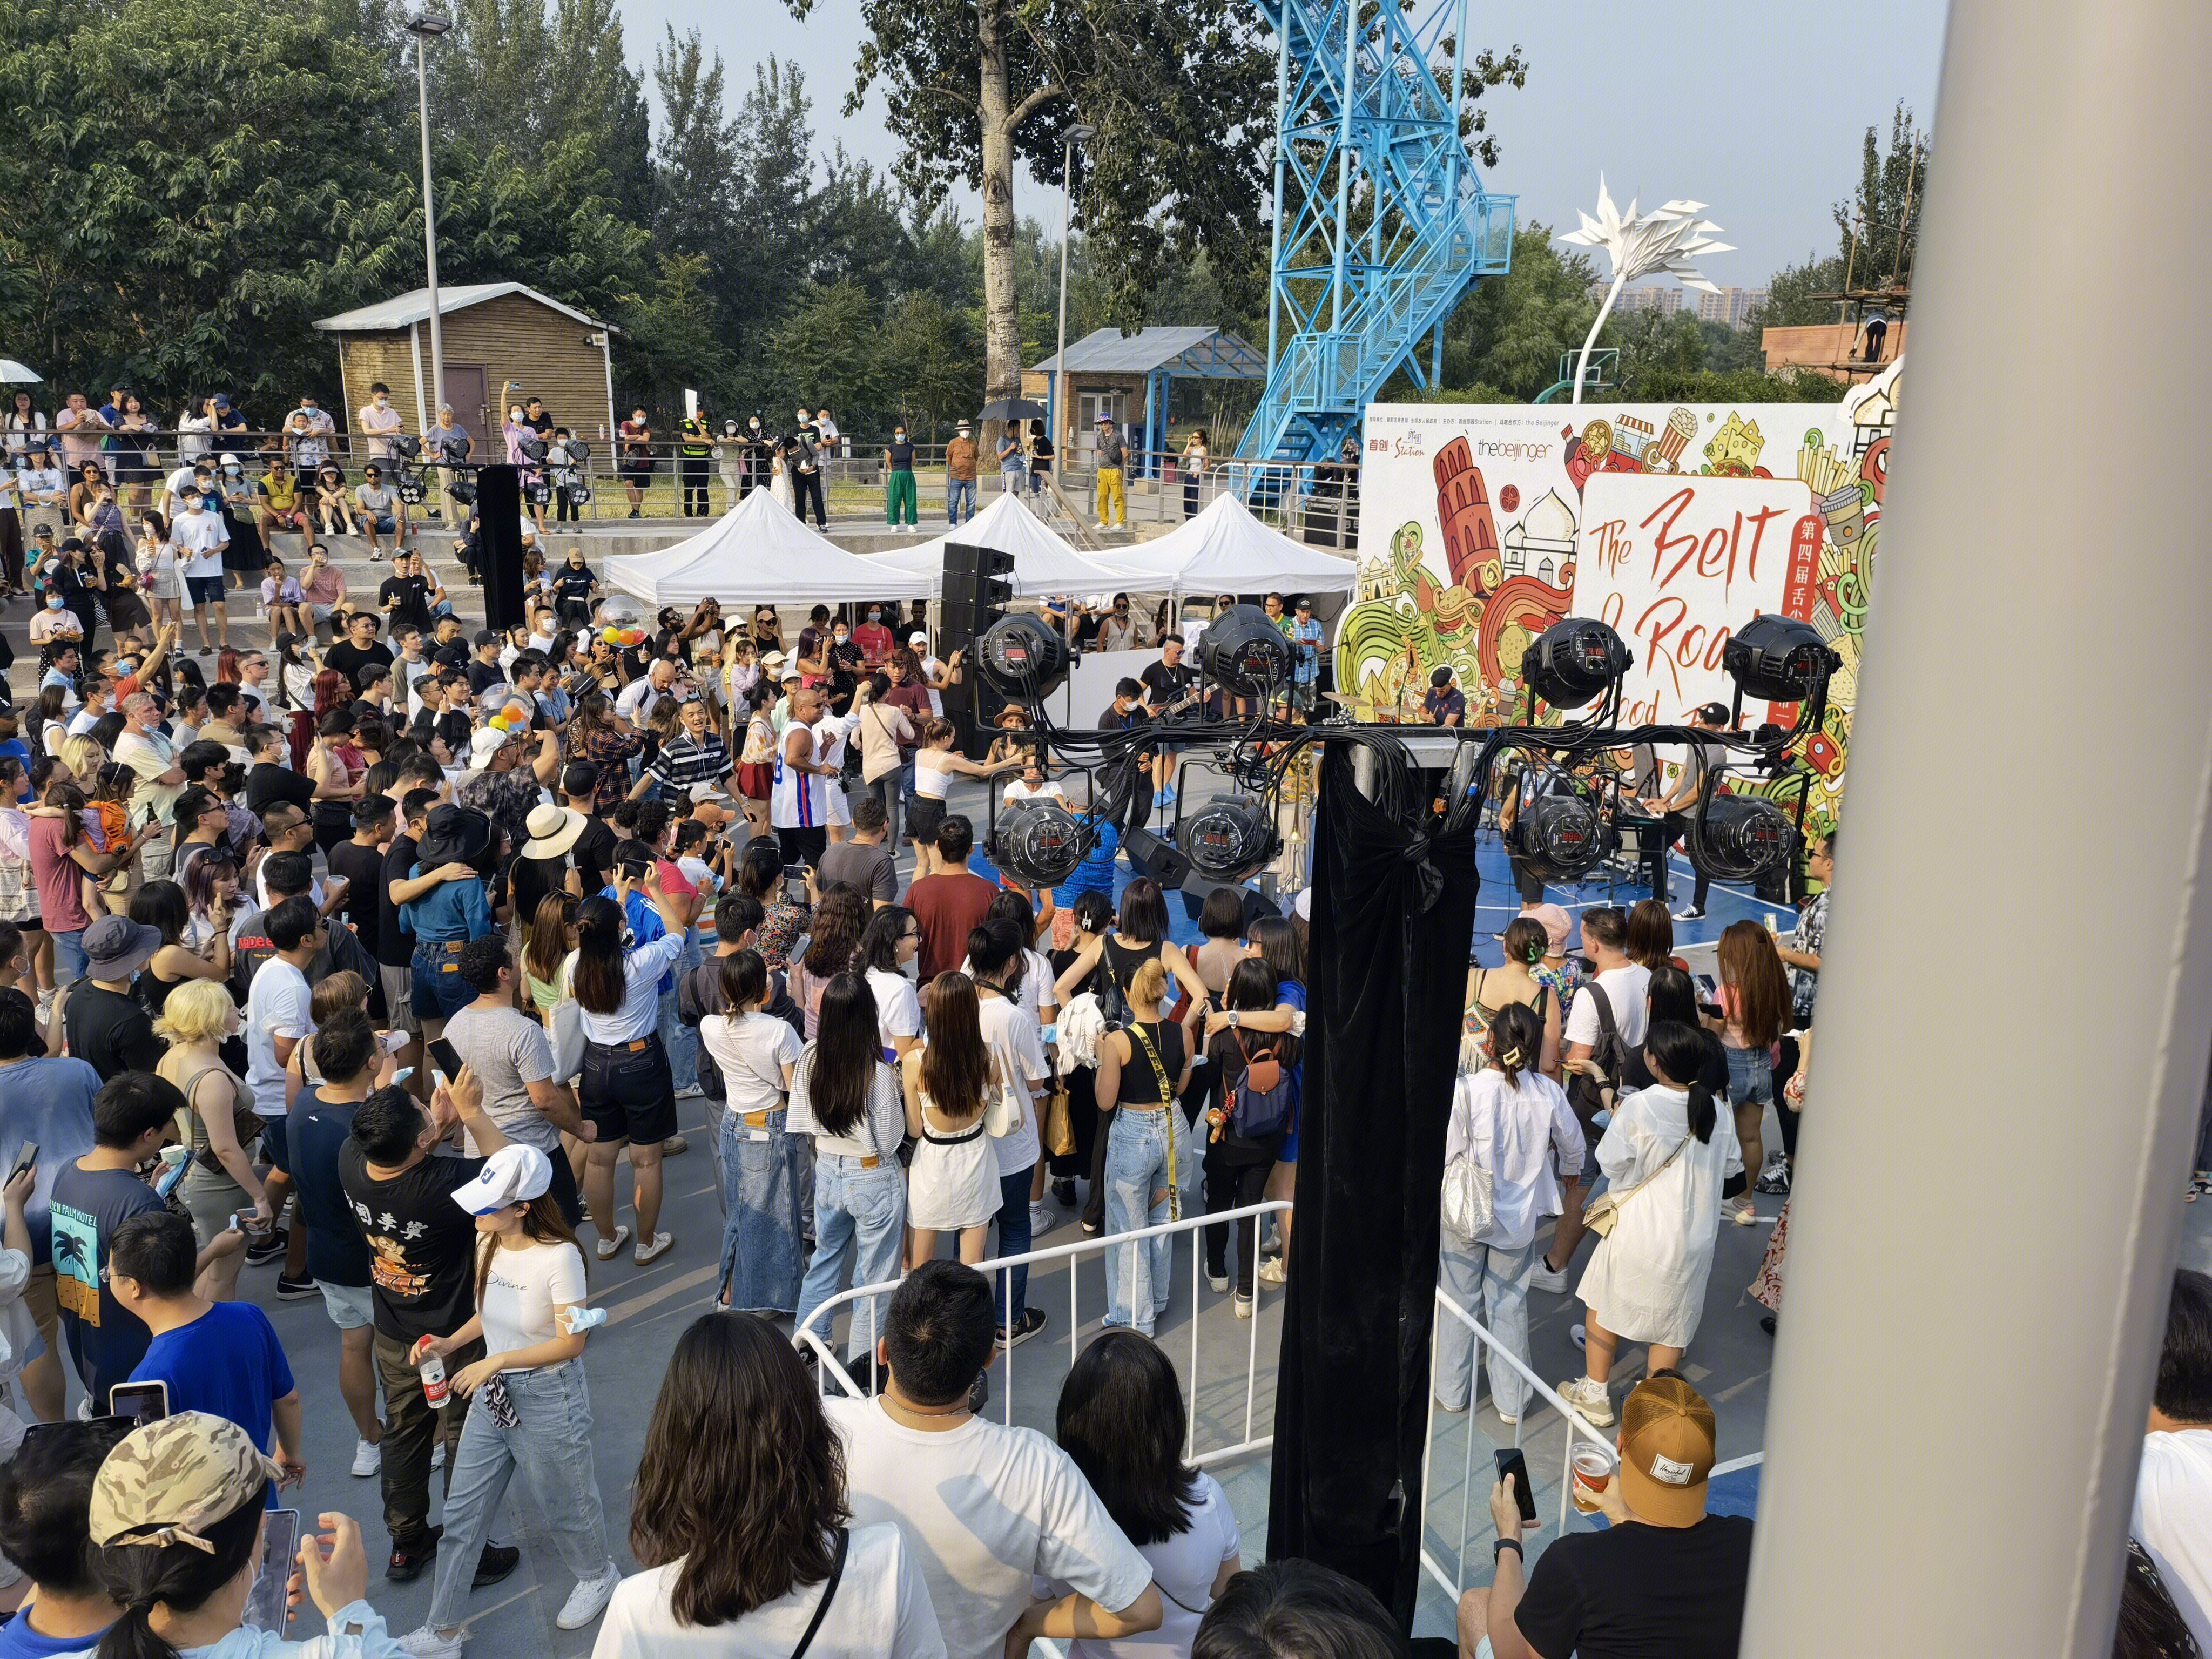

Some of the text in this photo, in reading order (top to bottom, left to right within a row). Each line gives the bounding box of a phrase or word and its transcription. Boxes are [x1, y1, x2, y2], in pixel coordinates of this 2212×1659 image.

[1369, 439, 1388, 451] 首创
[1394, 437, 1425, 458] Station
[1589, 488, 1791, 609] The Belt
[1634, 596, 1760, 708] Roa
[62, 1204, 77, 1220] PALM
[77, 1210, 98, 1228] MOTEL
[485, 1270, 528, 1291] Divine
